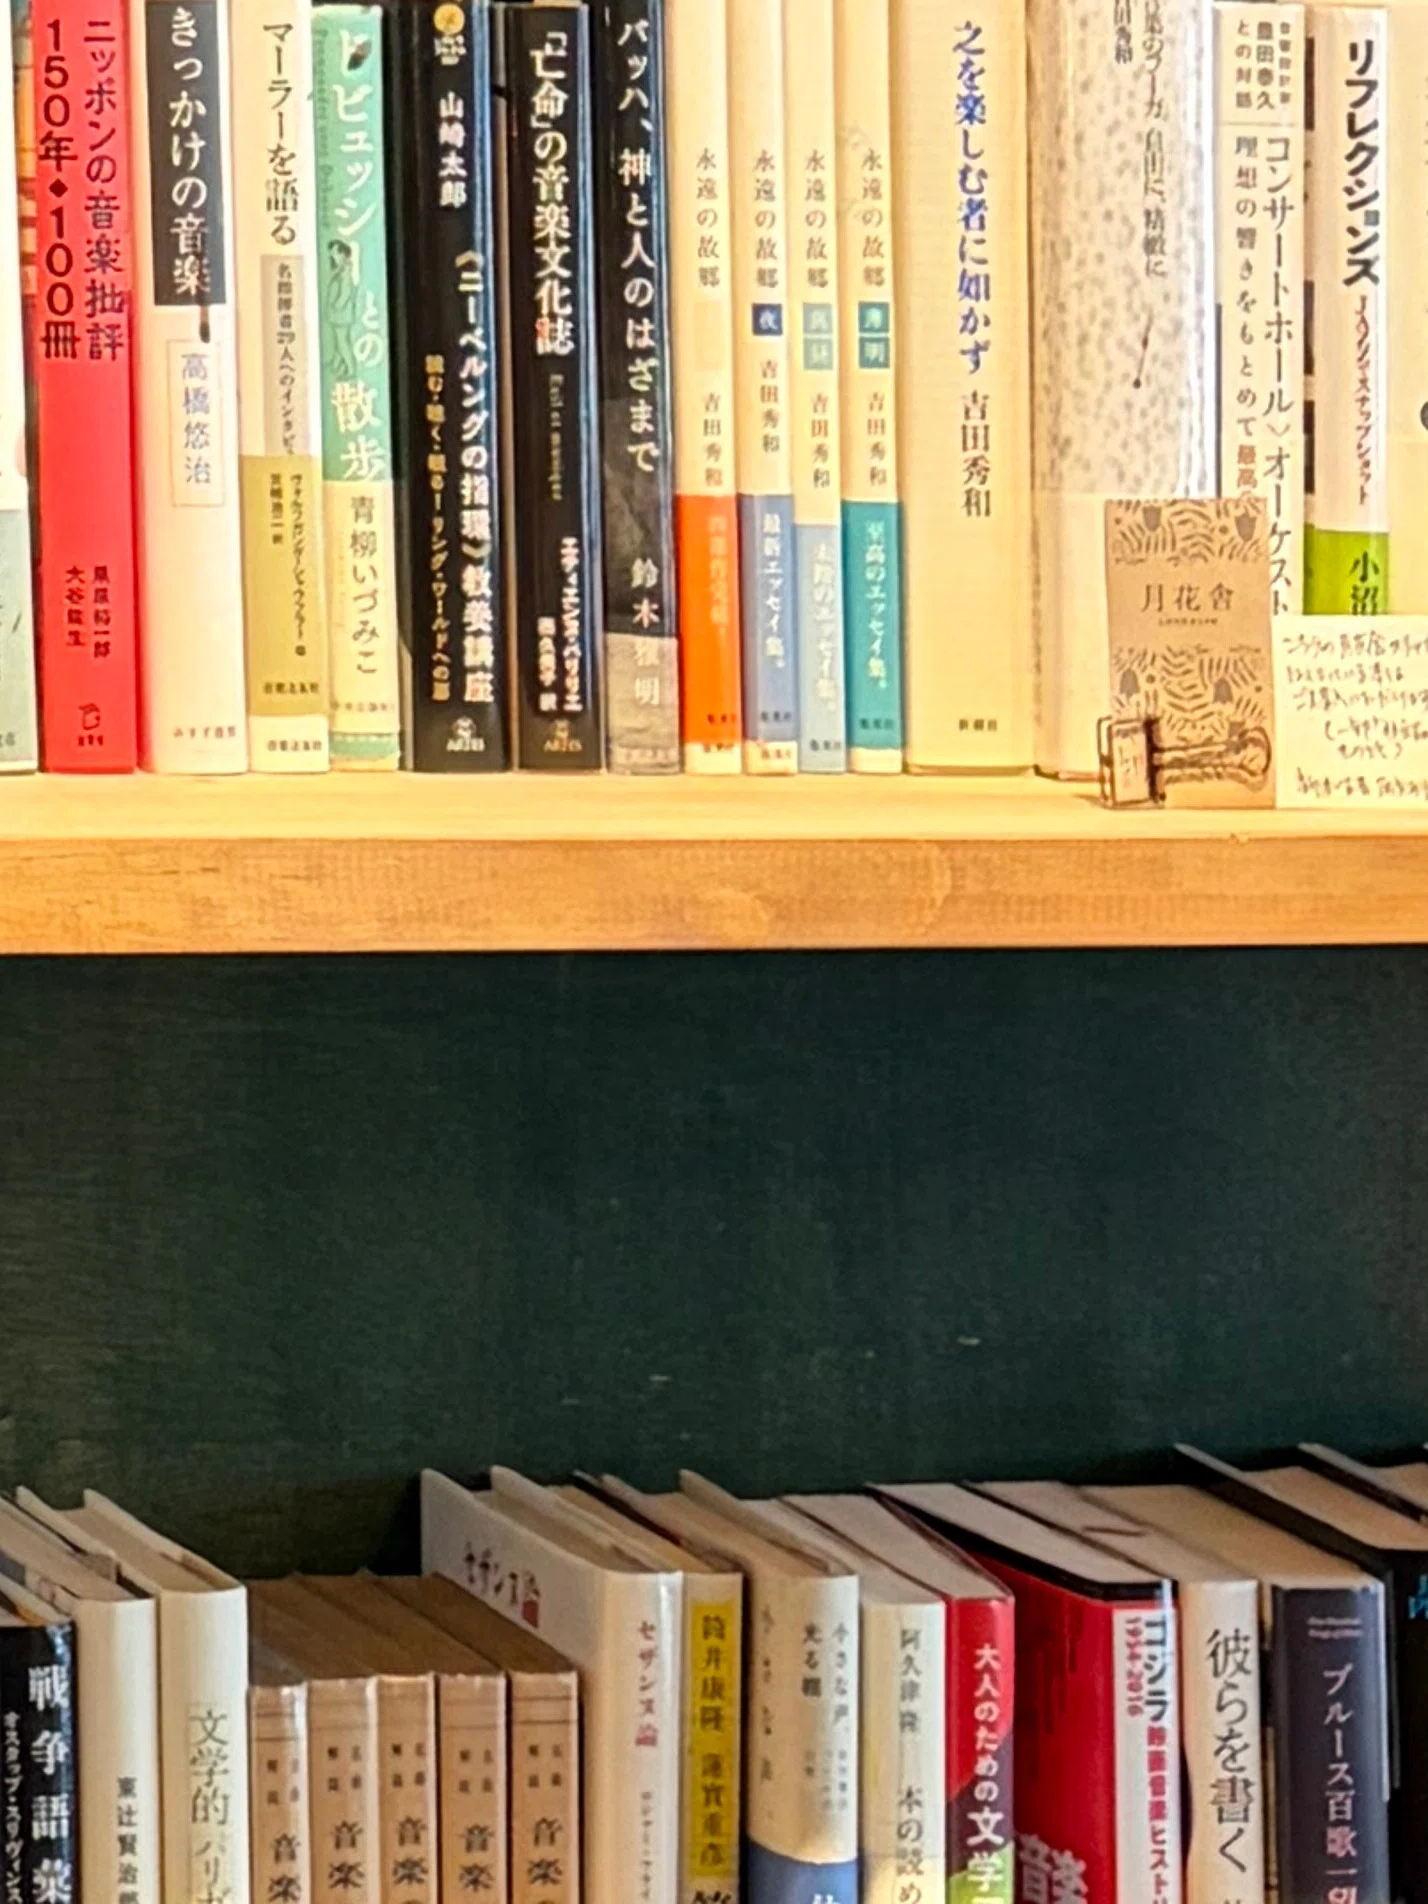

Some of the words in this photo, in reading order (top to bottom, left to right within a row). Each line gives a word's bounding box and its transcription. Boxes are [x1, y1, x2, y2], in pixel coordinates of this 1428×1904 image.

[81, 19, 126, 361] ニッポンの音楽批評
[166, 4, 212, 297] きっかけの音楽
[262, 22, 300, 246] マーラーを語る
[438, 90, 468, 210] 山崎太郎
[529, 30, 576, 357] 「亡命」の音楽文化誌
[952, 19, 993, 376] 之を楽しむ者に如かず
[1342, 38, 1381, 287] リフレクションズ
[329, 29, 387, 481] ドビュッシーとの散歩
[616, 18, 661, 474] バッハ、神と人のはざまで
[695, 147, 721, 289] 永遠の故郷
[753, 148, 779, 290] 永遠の故郷
[804, 148, 830, 289] 永遠の故郷
[860, 148, 886, 289] 永遠の故郷
[1234, 135, 1260, 438] 理想の響きをもとめて
[178, 350, 214, 489] 高橋悠治
[702, 391, 724, 488] 吉田秀和
[759, 359, 781, 454] 吉田秀和
[810, 392, 831, 489] 吉田秀和
[866, 391, 888, 488] 吉田秀和
[959, 391, 994, 520] 吉田秀和
[347, 496, 381, 677] 青柳いづみこ
[1140, 582, 1235, 615] 月花舎
[1349, 550, 1381, 616] 小沼
[634, 1620, 659, 1748] セザンヌ論
[699, 1613, 727, 1731] 筒井康隆
[899, 1629, 923, 1733] 阿久津隆
[966, 1642, 1006, 1892] 大人のための文学
[1207, 1627, 1255, 1874] 彼らを書く
